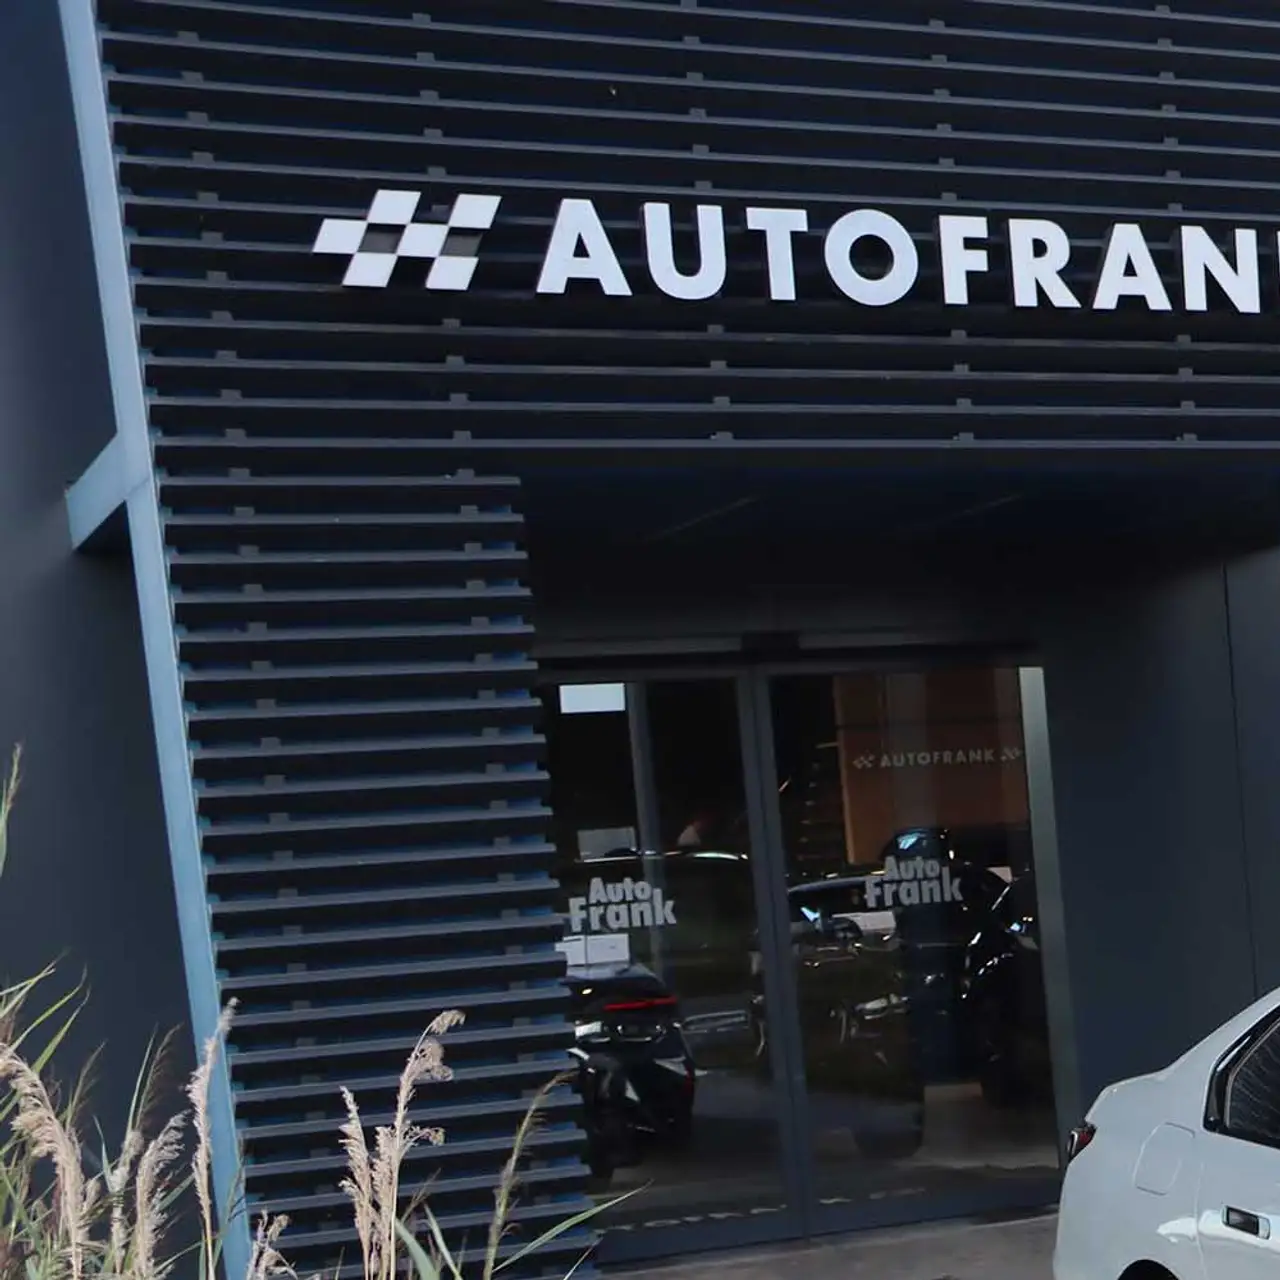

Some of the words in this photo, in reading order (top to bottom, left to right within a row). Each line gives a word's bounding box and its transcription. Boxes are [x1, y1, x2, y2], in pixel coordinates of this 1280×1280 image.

[880, 749, 995, 768] AUTOFRANK
[885, 855, 940, 880] Auto
[588, 877, 652, 903] Auto
[865, 867, 963, 908] Frank
[568, 888, 677, 932] Frank
